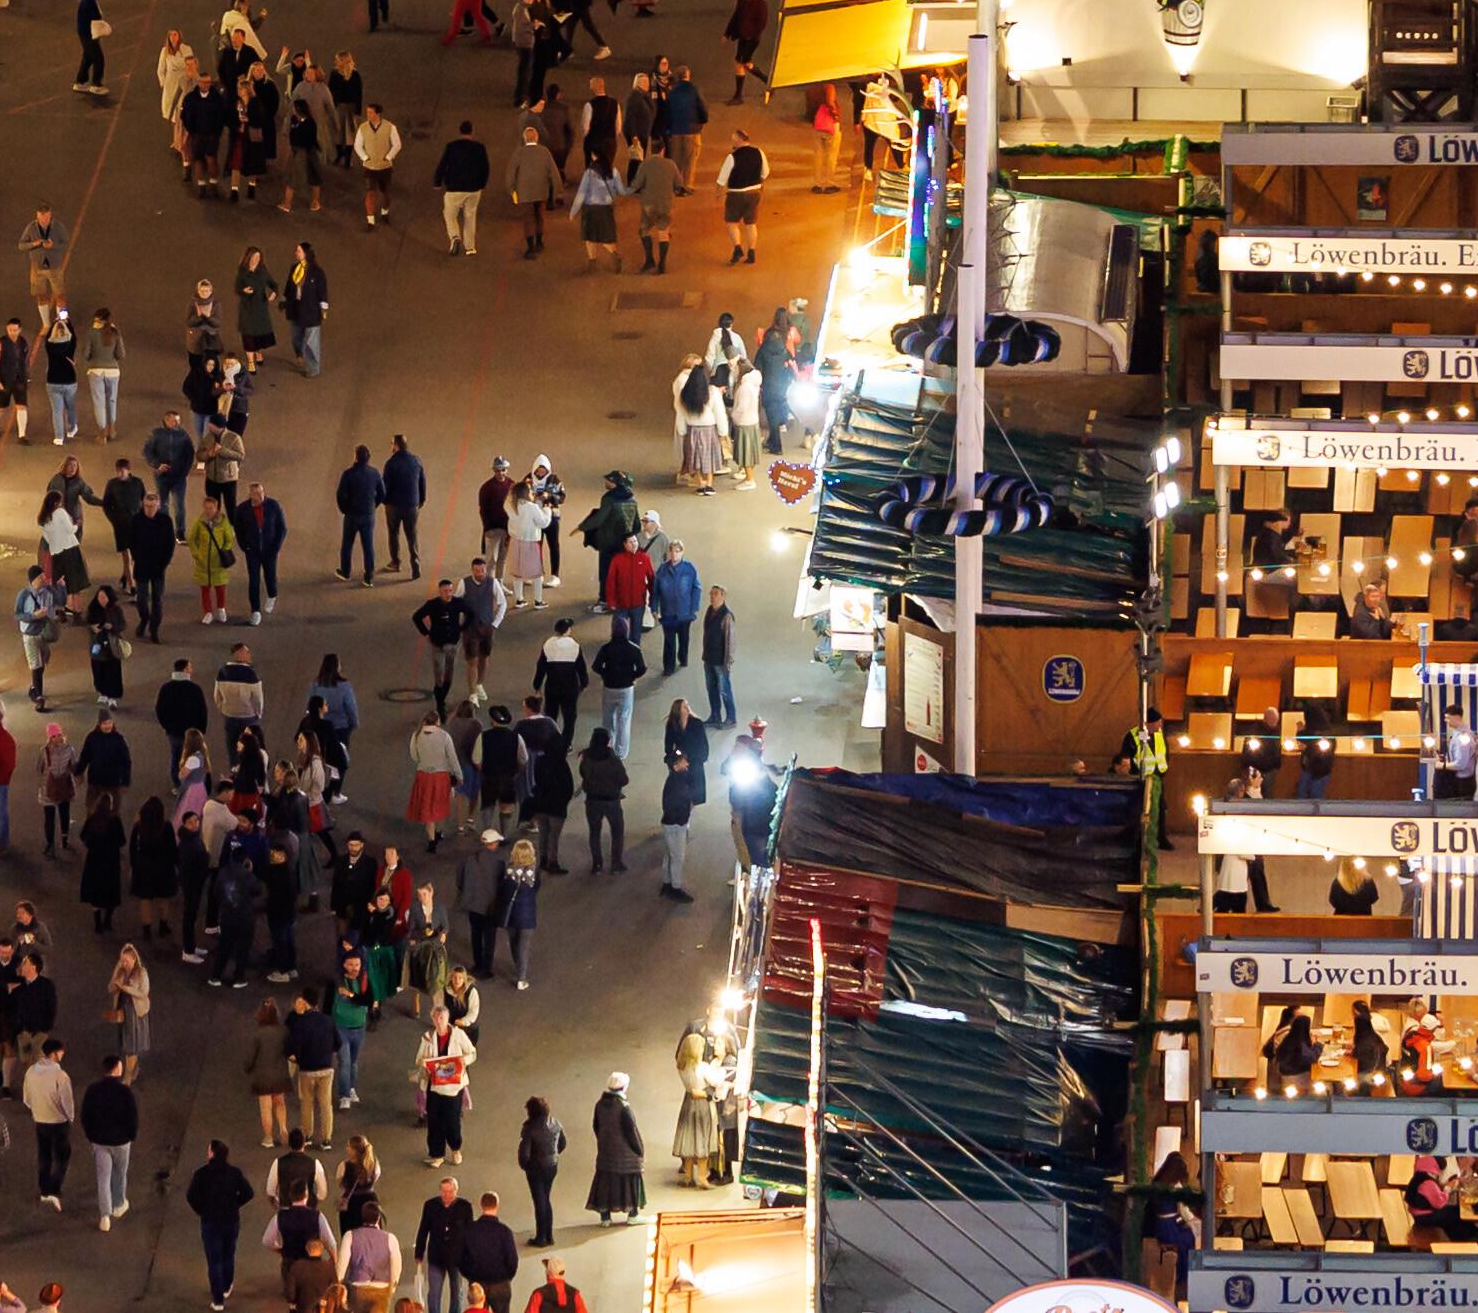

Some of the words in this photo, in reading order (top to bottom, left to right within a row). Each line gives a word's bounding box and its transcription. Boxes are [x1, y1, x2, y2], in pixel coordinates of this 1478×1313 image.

[1292, 240, 1447, 268] Löwenbräu.
[1302, 435, 1466, 463] Löwenbräu.
[1281, 958, 1468, 988] Löwenbräu.
[1278, 1275, 1478, 1308] Löwenbräu.
